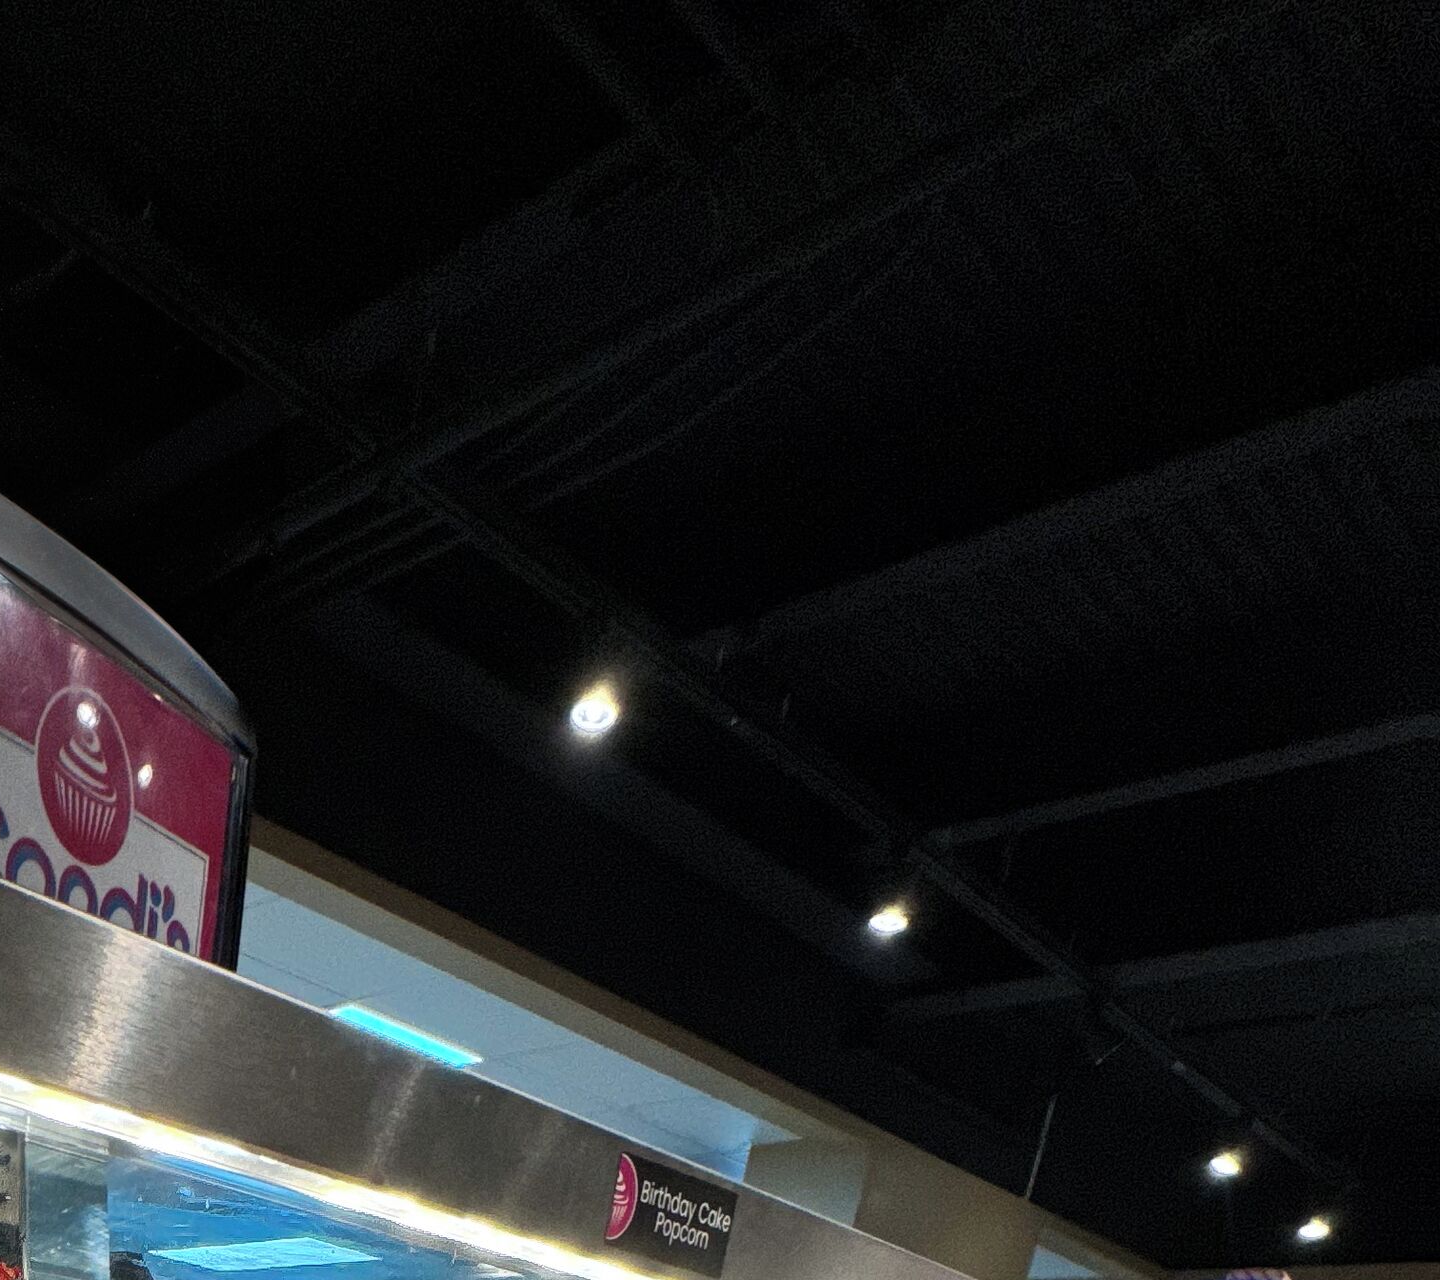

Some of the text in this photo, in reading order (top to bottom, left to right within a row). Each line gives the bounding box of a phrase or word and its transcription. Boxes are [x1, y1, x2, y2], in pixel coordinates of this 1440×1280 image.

[640, 1180, 731, 1233] Birthday Cake
[654, 1212, 709, 1250] Popcorn
